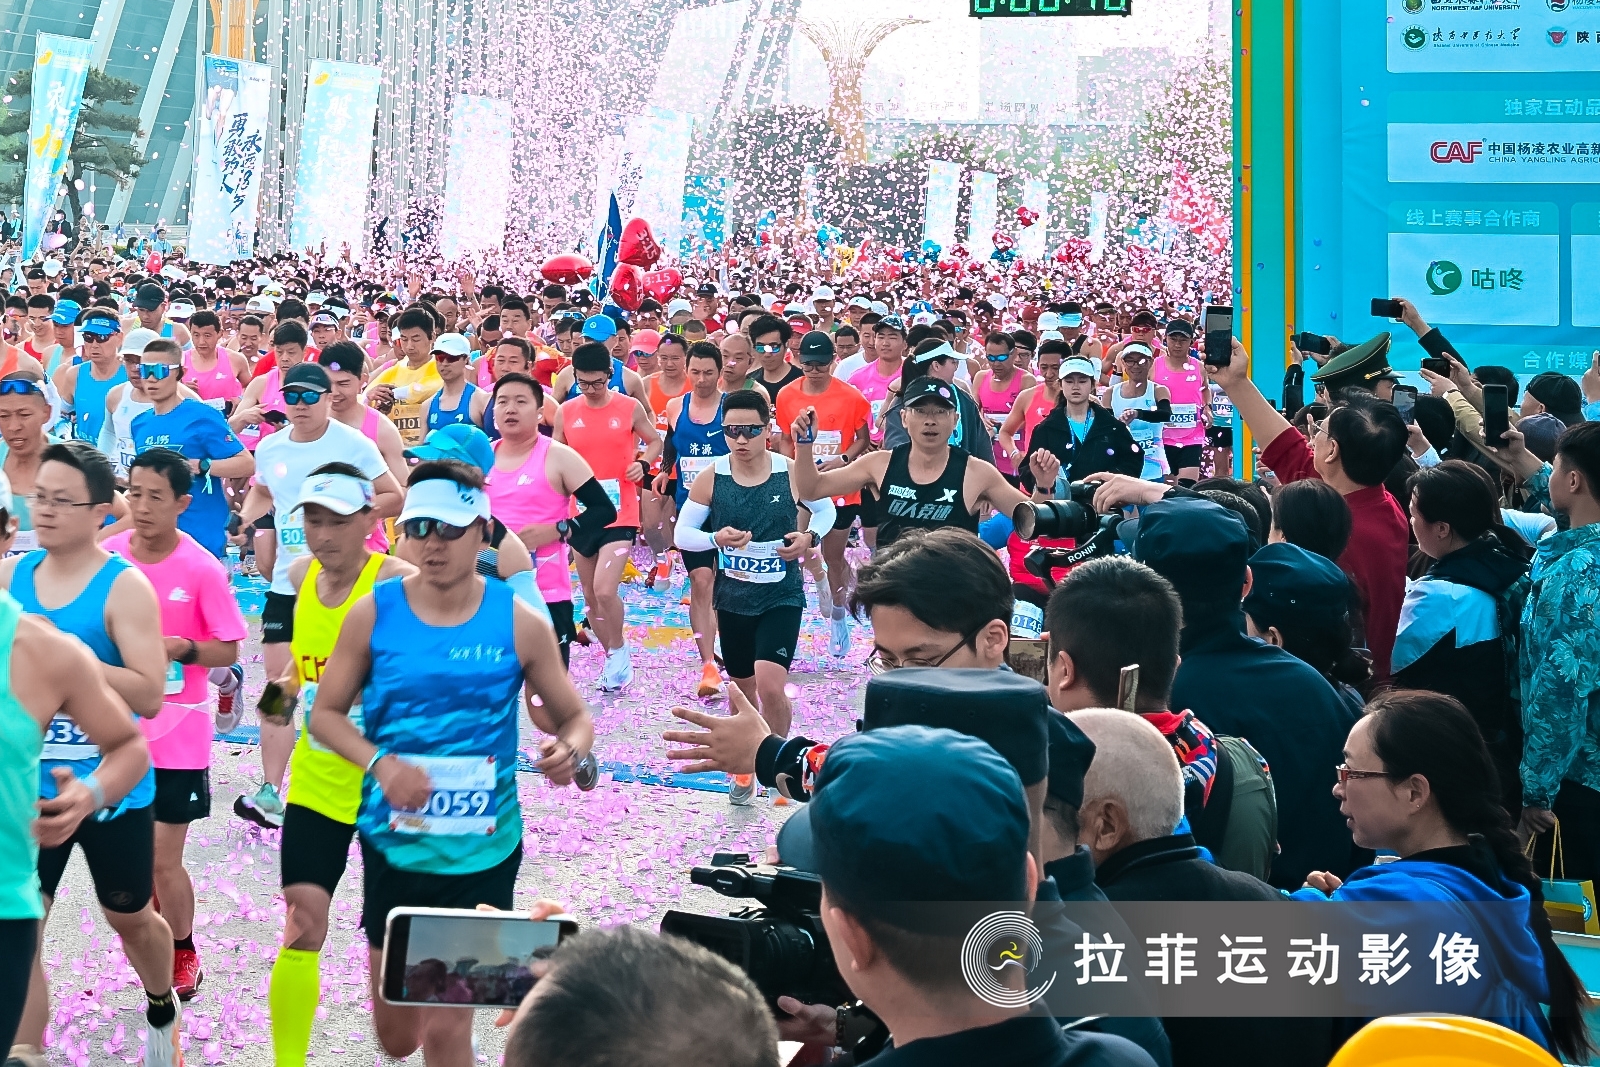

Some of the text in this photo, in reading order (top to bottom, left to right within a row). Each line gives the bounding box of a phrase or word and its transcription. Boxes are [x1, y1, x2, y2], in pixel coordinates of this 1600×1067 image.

[1504, 98, 1600, 116] 独家互动品
[1430, 140, 1483, 164] CAF
[1487, 141, 1600, 156] 中国杨凌农业高新
[1406, 209, 1541, 227] 线上赛事合作商
[644, 271, 671, 286] 3:15
[1471, 267, 1524, 291] 咕咚
[1522, 350, 1588, 369] 合作媒
[689, 442, 713, 456] 济源
[1067, 542, 1098, 564] RONIN
[728, 556, 782, 573] 10254
